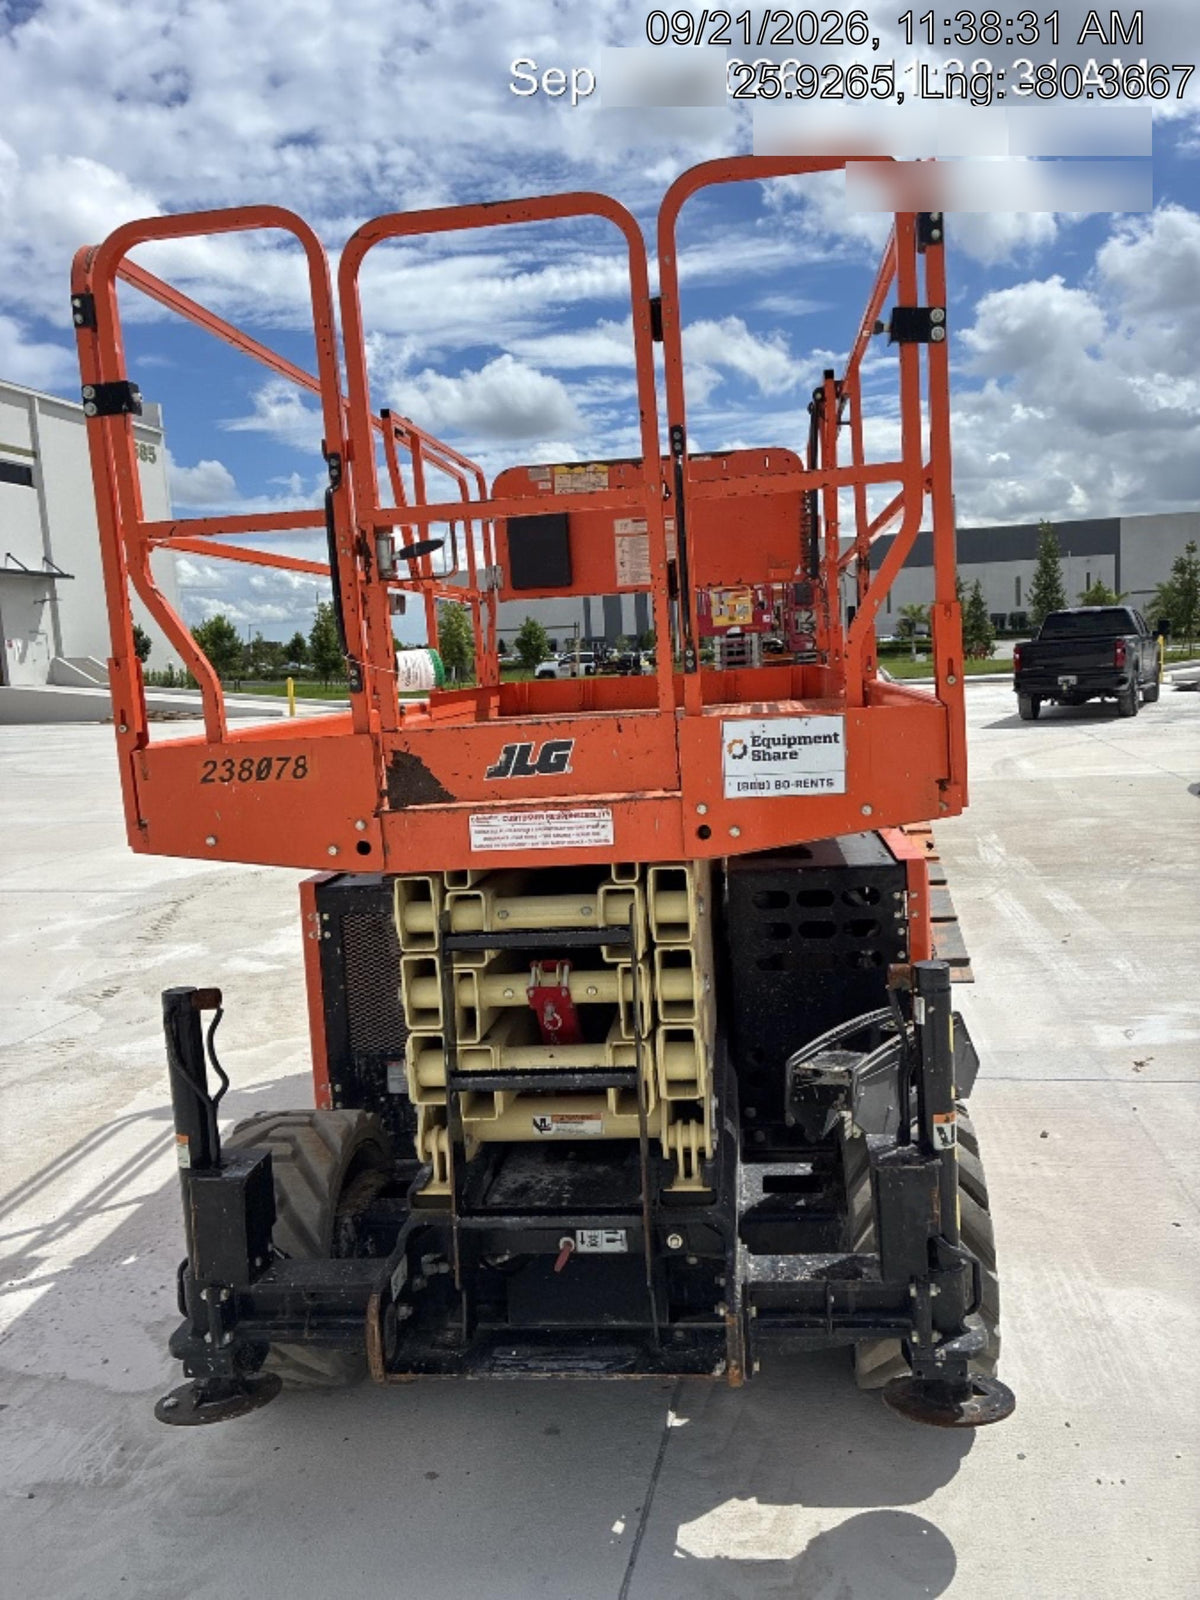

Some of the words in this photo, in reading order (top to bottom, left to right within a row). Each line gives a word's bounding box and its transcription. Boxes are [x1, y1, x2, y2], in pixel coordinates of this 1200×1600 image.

[750, 731, 840, 749] Equipment
[483, 738, 575, 781] JLG
[750, 749, 799, 762] Share
